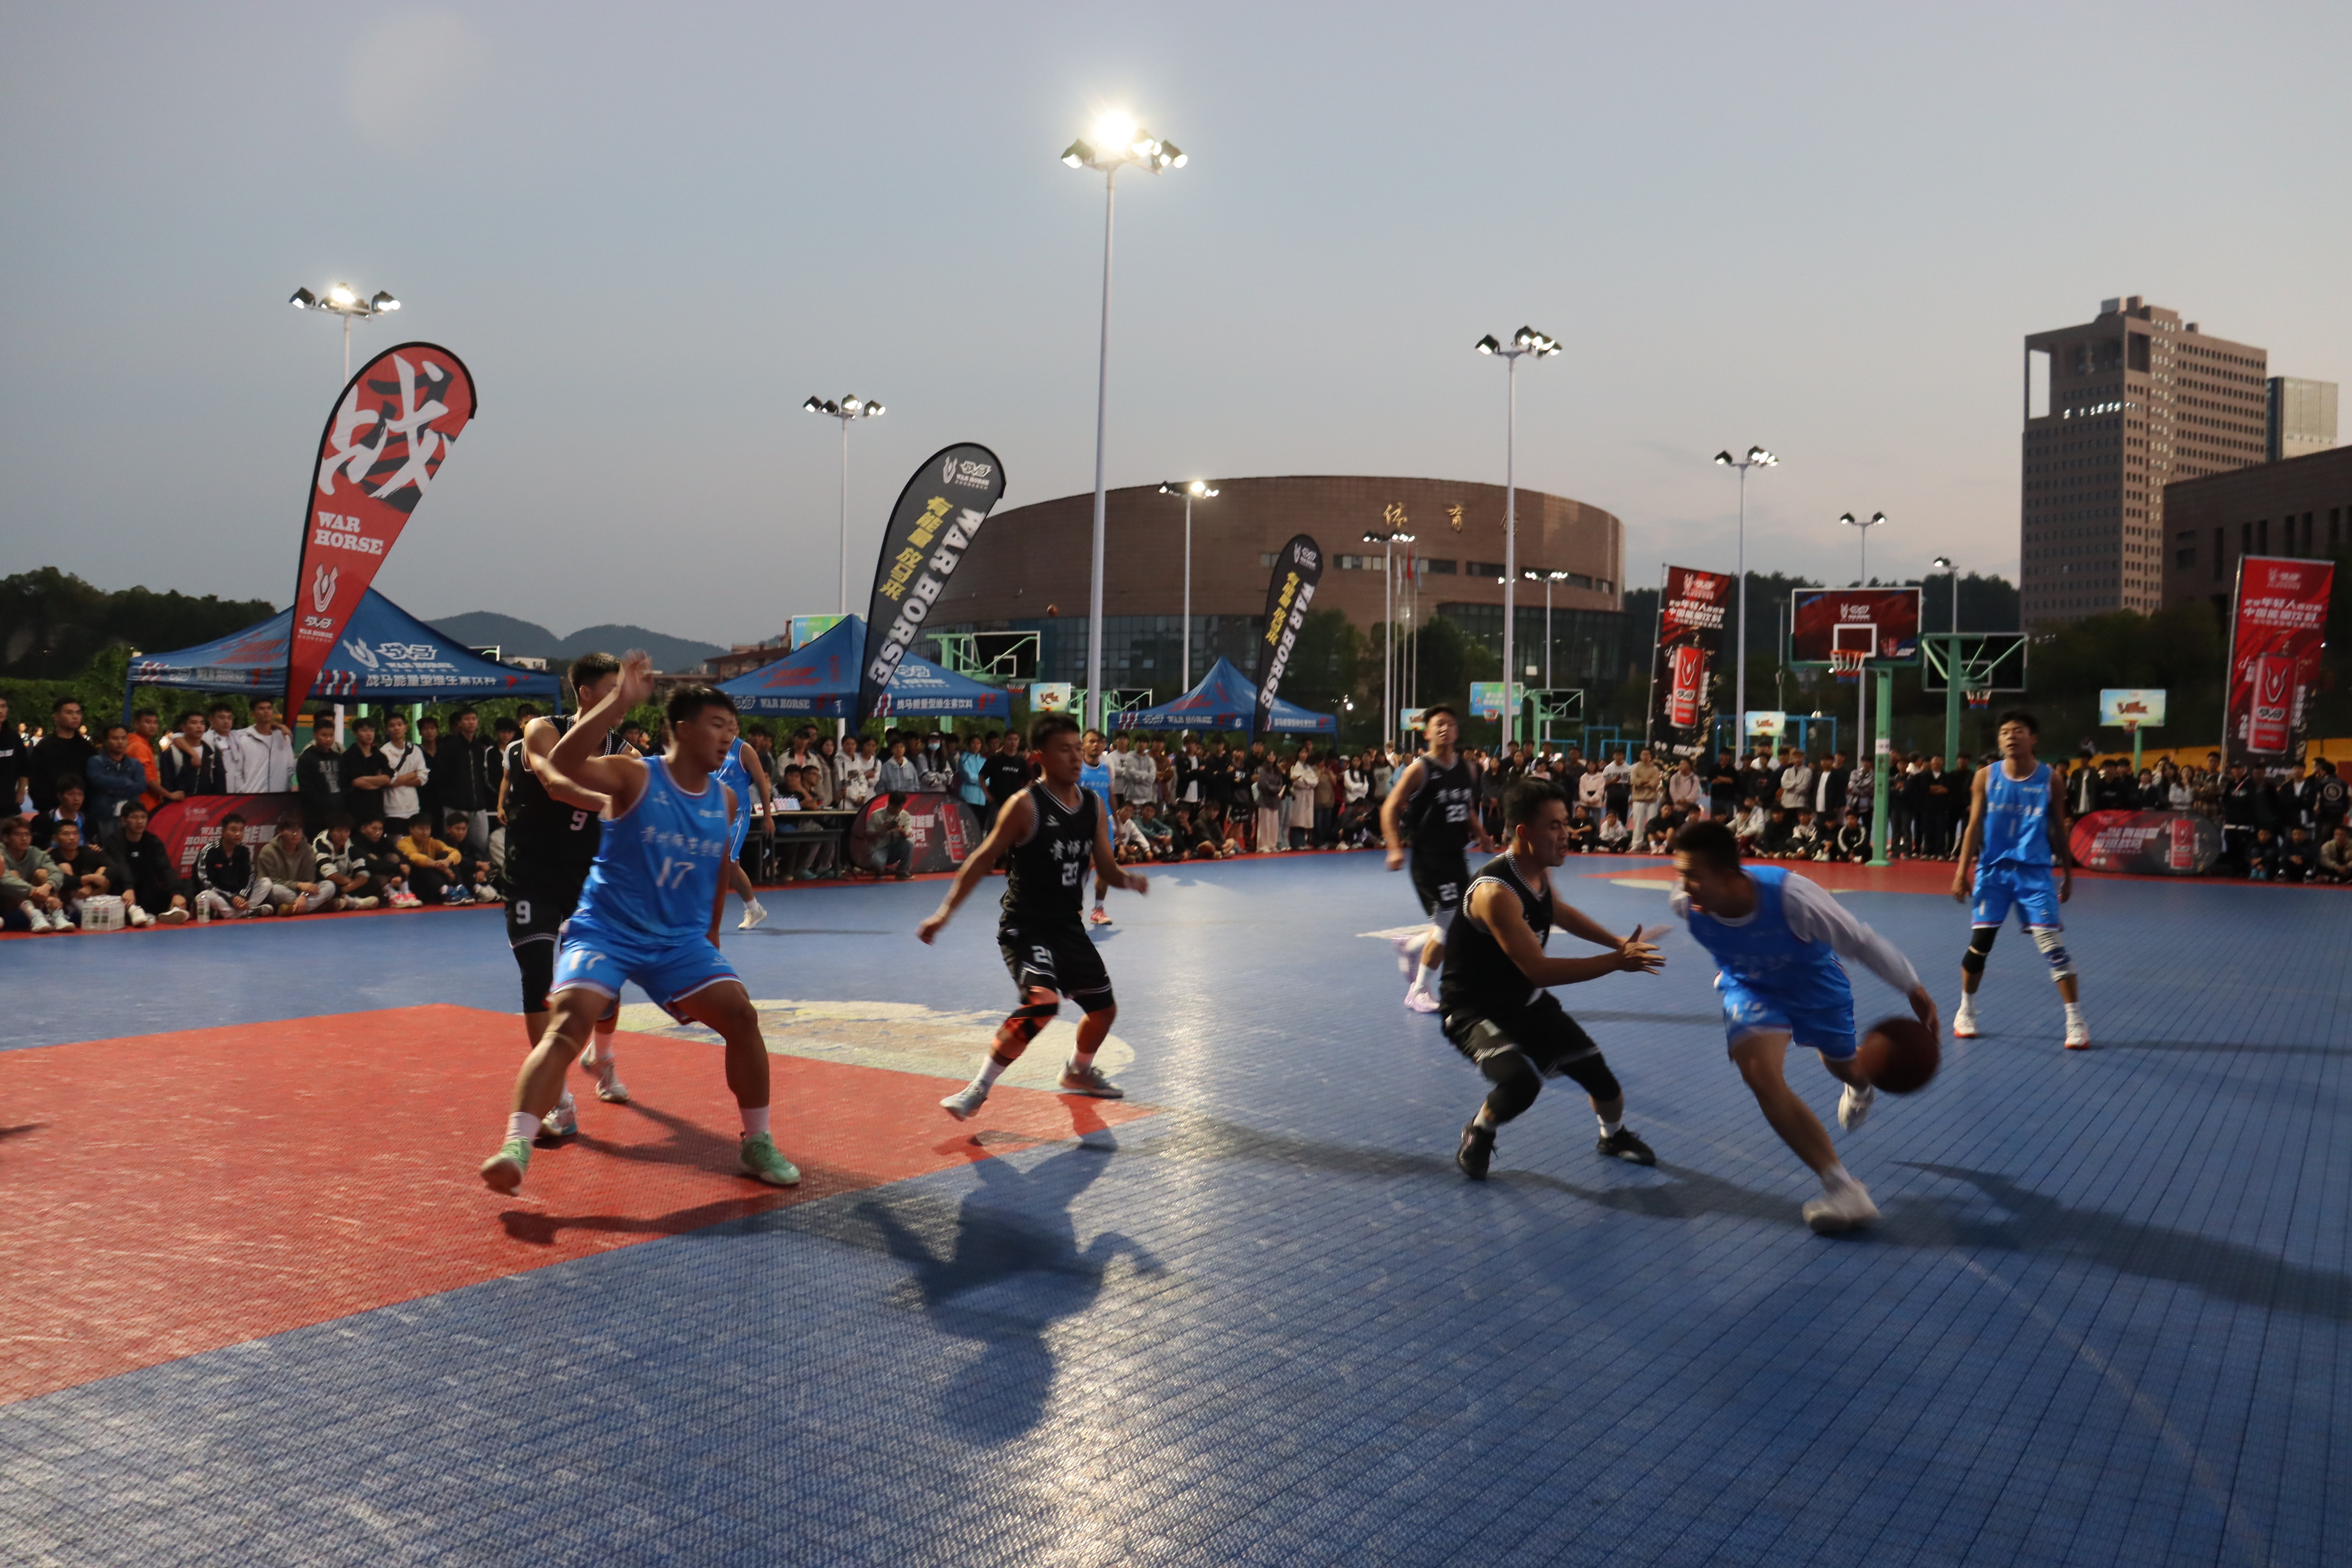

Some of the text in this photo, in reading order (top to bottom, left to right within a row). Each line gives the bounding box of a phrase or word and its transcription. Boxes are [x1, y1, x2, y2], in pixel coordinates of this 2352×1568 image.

[318, 511, 361, 533] WAR
[314, 529, 384, 555] HORSE
[929, 508, 986, 576] WAR
[1289, 582, 1315, 630] WAR
[867, 571, 944, 687] HORSE
[1260, 625, 1296, 709] HORSE
[365, 674, 497, 687] 战马能量型维生素饮料
[760, 698, 811, 709] WAR HORSE
[897, 698, 973, 710] 战马能量型维生素饮料
[570, 811, 588, 831] 9
[656, 856, 695, 889] 17
[515, 900, 531, 925] 9
